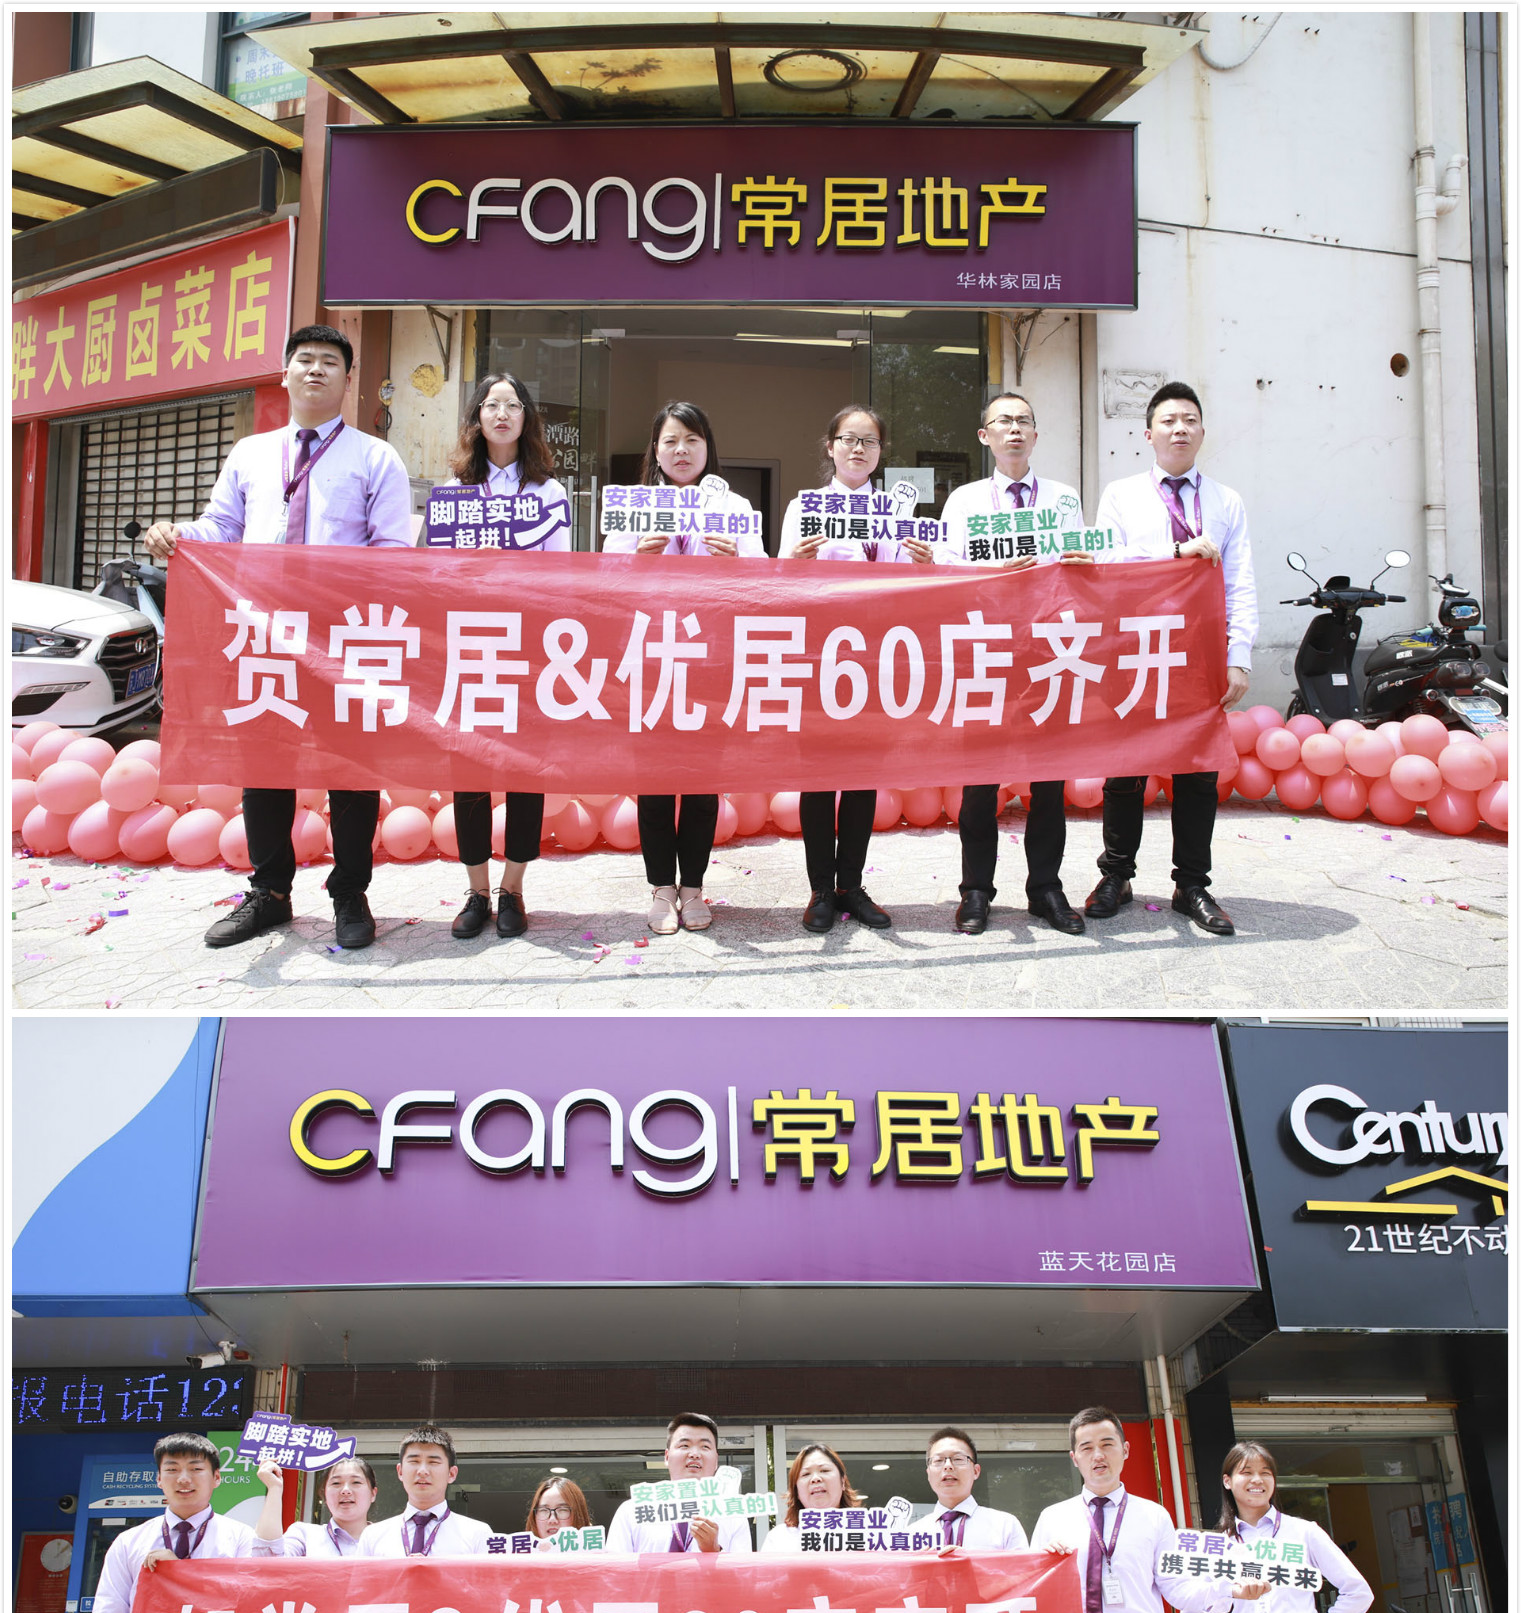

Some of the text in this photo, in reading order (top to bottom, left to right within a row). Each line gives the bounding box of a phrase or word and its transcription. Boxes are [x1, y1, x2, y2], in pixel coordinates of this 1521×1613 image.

[730, 175, 1048, 250] 常居地产
[956, 271, 1062, 291] 华林家园店
[12, 250, 273, 400] 胖大厨卤菜店
[429, 497, 540, 526] 脚踏实地
[605, 486, 700, 509] 安家置业
[801, 491, 893, 516] 安家置业
[967, 508, 1058, 537] 安家置业
[222, 599, 1187, 732] 贺常居&优居60店齐开
[752, 1087, 1161, 1183] 常居地产
[1039, 1250, 1177, 1274] 蓝天花园店
[243, 1421, 333, 1450] 脚踏实地
[103, 1471, 158, 1484] 自助存取
[633, 1479, 720, 1503] 安家置业
[801, 1509, 888, 1530] 安家置业
[486, 1528, 604, 1554] 常居 优居
[1178, 1532, 1304, 1564] 常居 优居
[1161, 1553, 1320, 1589] 携手共赢未来
